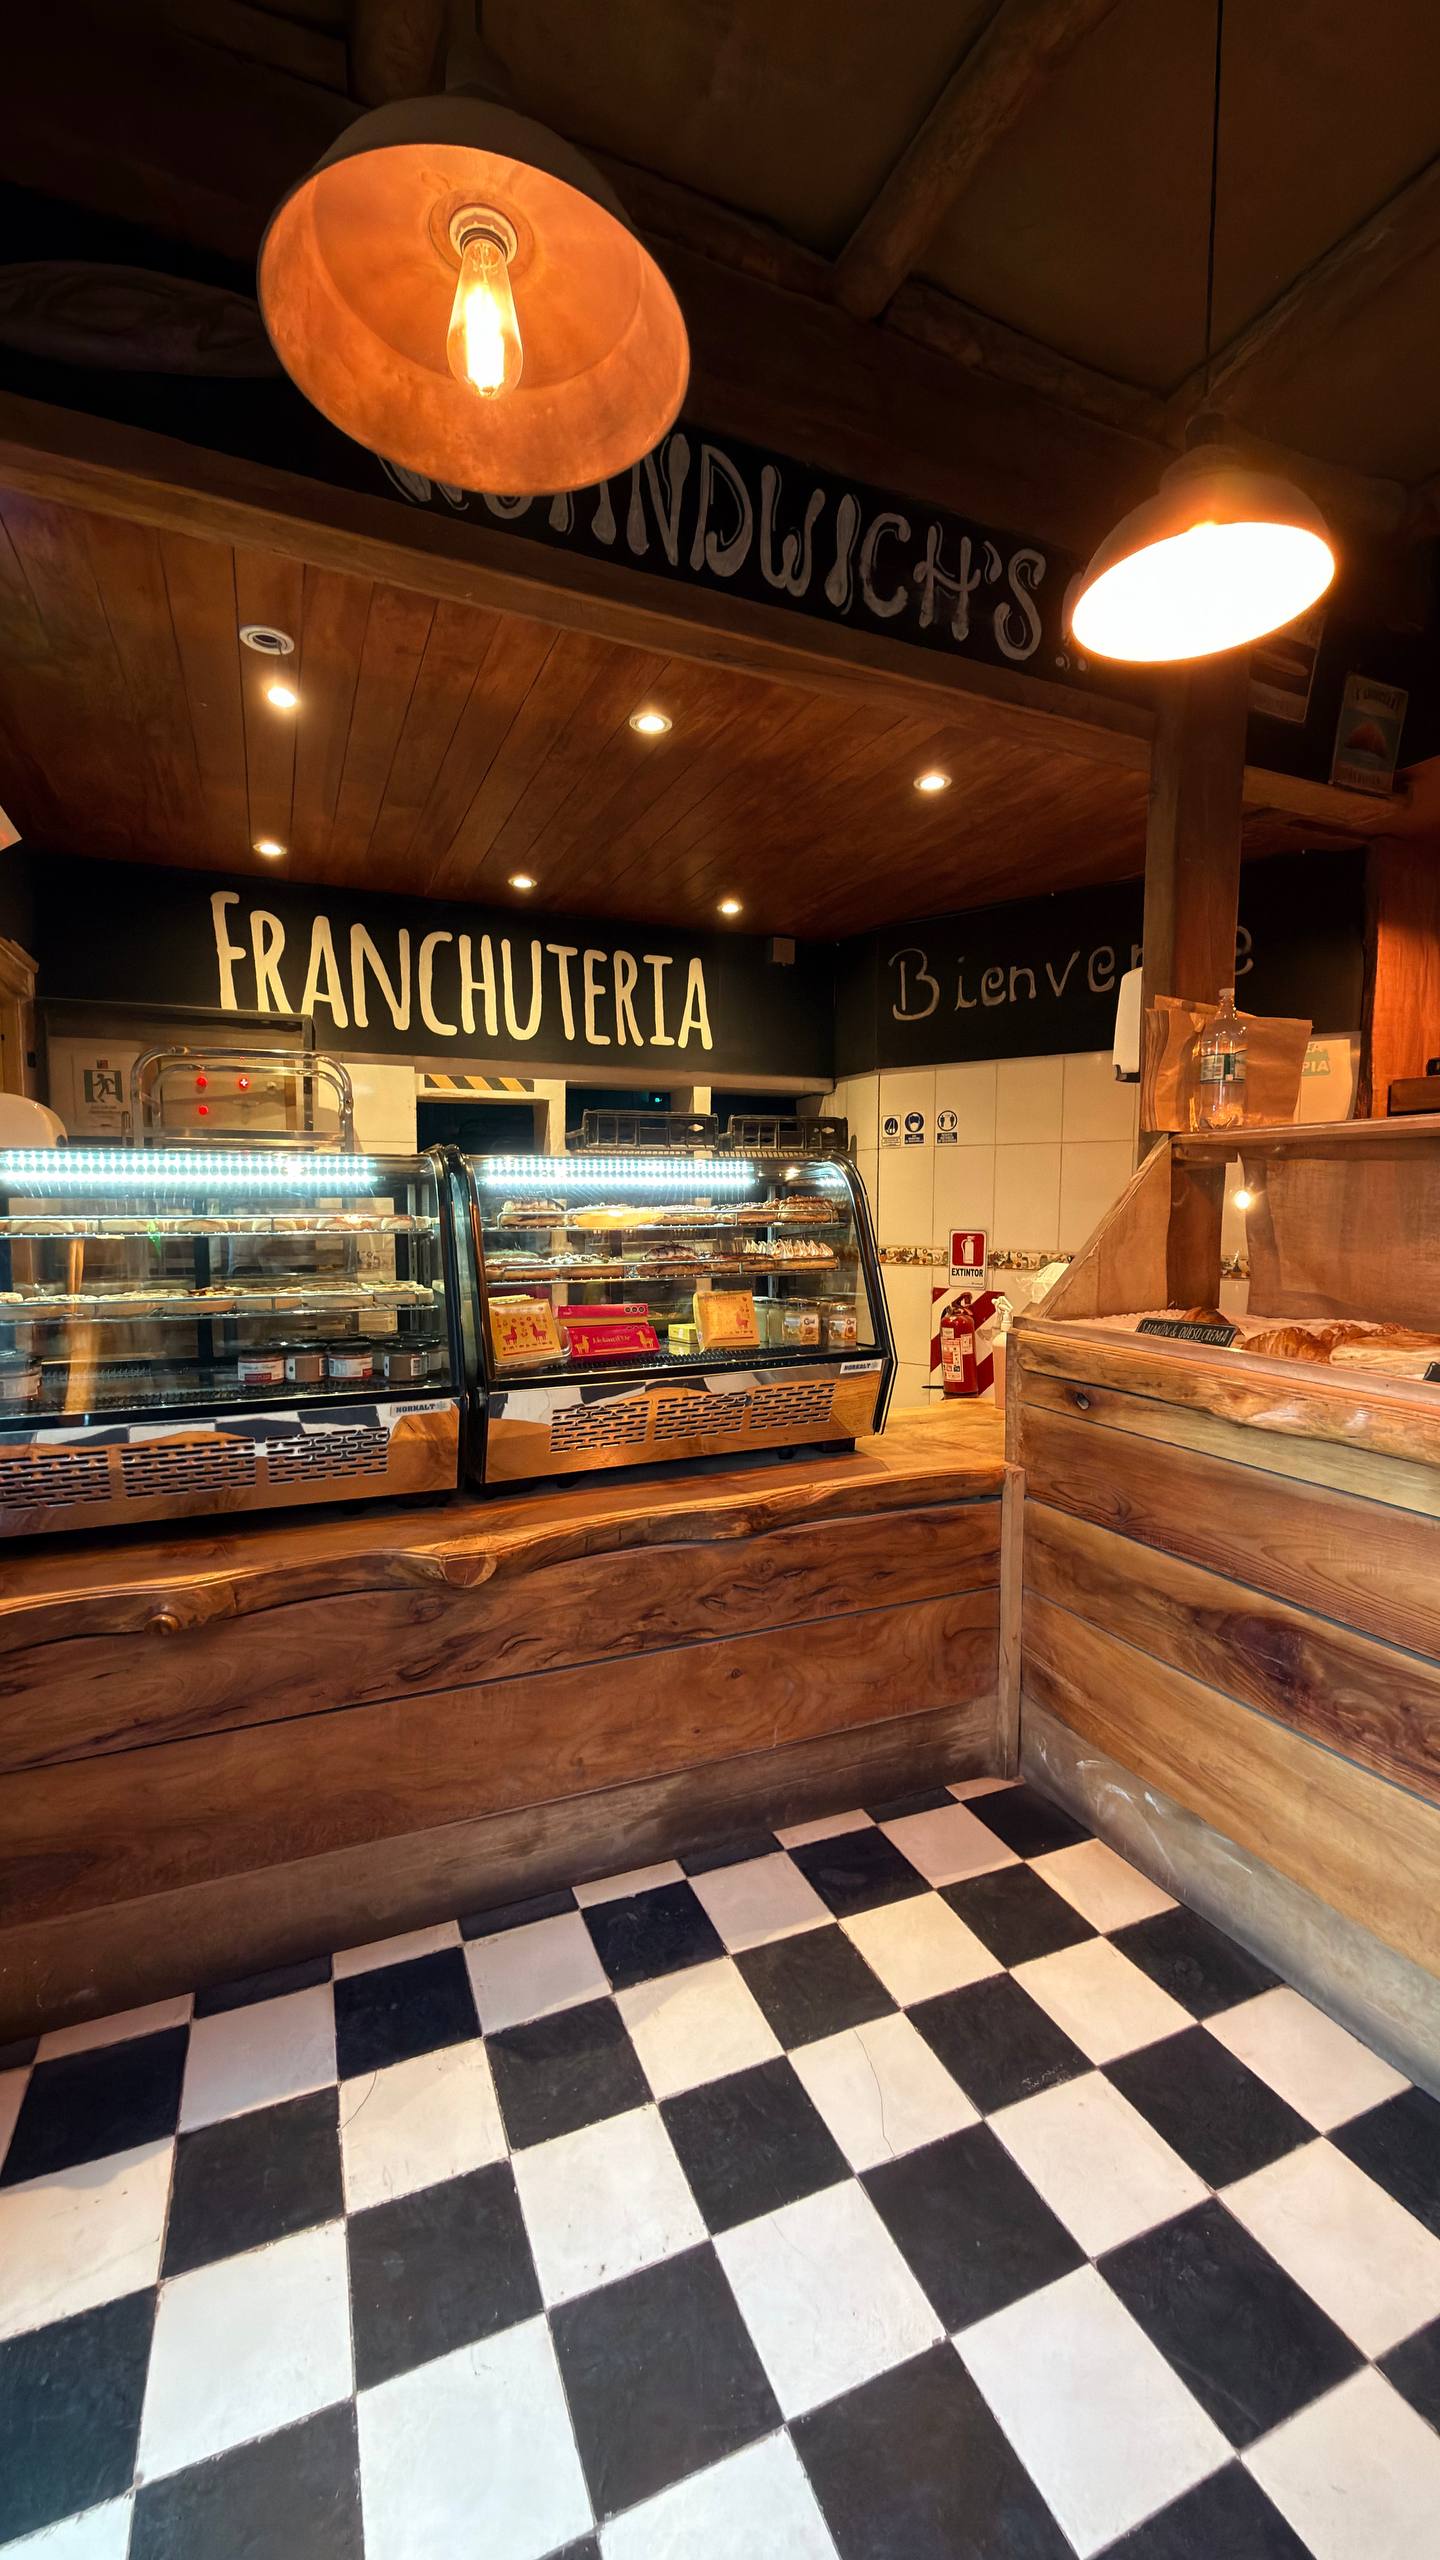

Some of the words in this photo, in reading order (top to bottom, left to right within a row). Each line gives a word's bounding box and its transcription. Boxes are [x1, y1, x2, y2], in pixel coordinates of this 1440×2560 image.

[210, 891, 714, 1051] FRANCHUTERIA
[951, 1268, 984, 1277] EXTINTOR
[1170, 1325, 1177, 1337] &
[1202, 1328, 1229, 1342] CREMA
